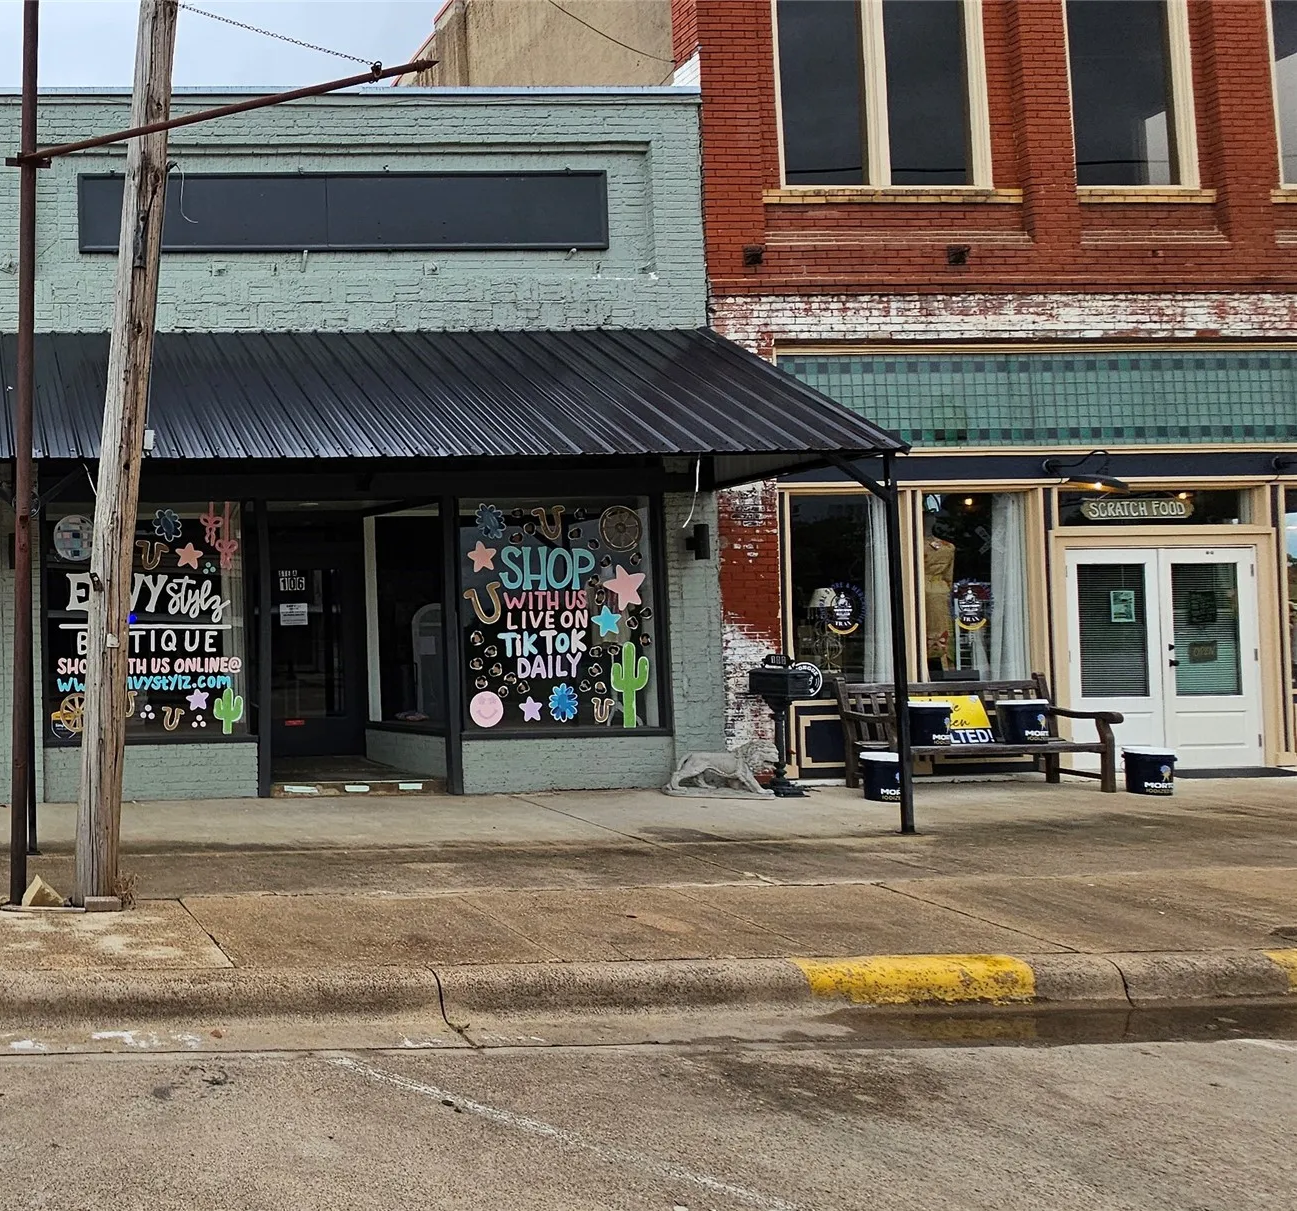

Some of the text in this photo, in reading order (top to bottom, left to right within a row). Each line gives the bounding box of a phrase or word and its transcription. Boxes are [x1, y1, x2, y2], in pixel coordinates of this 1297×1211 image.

[1089, 500, 1186, 518] SCRATCH FOOD
[498, 546, 596, 590] SHOP
[66, 572, 168, 613] EVY
[280, 576, 305, 590] 106
[504, 590, 588, 610] WITH US
[506, 609, 588, 630] LIVE ON
[77, 630, 218, 655] BTIQUE
[57, 658, 87, 675] SHO
[151, 657, 170, 674] US
[517, 652, 582, 679] DAILY
[950, 729, 996, 743] LTED!
